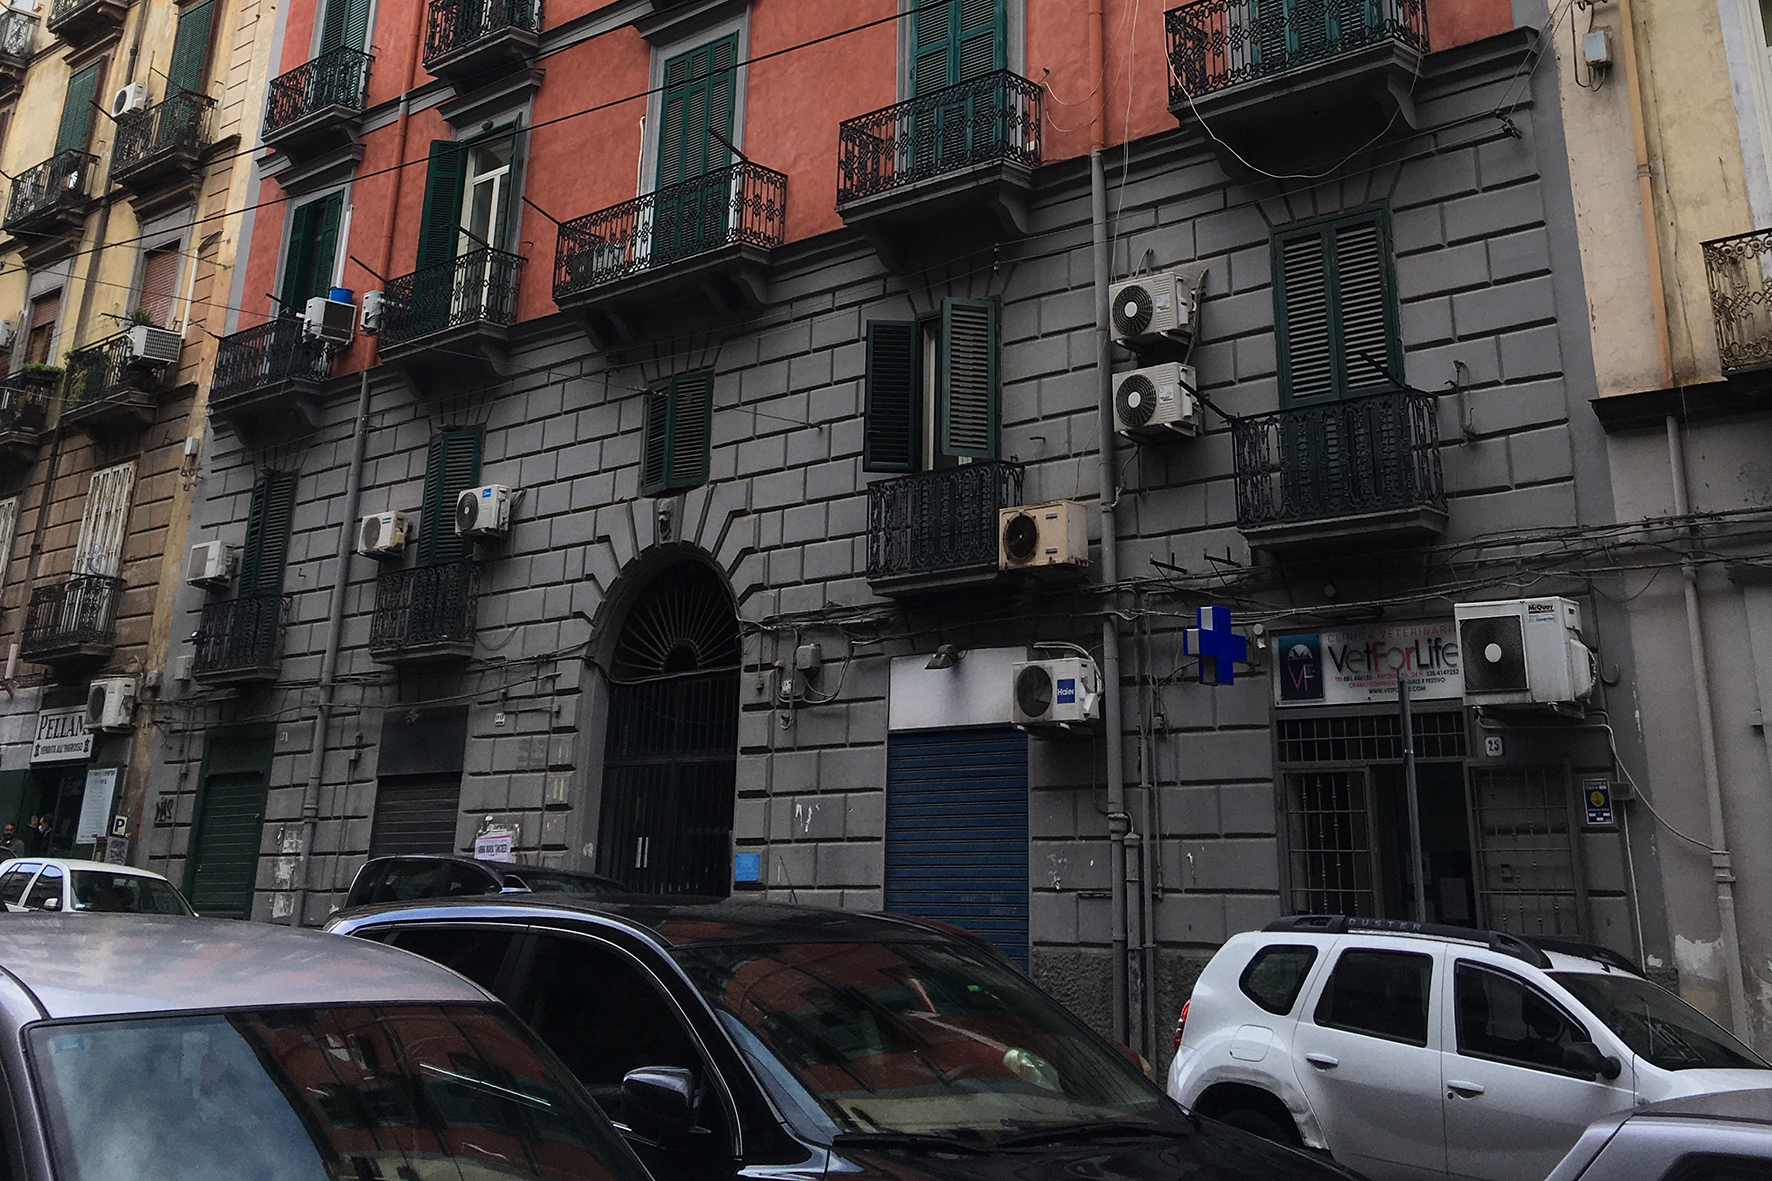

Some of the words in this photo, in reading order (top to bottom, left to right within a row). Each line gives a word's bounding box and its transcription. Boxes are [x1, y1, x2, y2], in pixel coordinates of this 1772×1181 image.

[1327, 631, 1374, 644] CLINICA
[1057, 687, 1075, 696] Haier
[1487, 739, 1500, 751] 25
[114, 818, 125, 832] P
[1348, 918, 1421, 931] DUSTER
